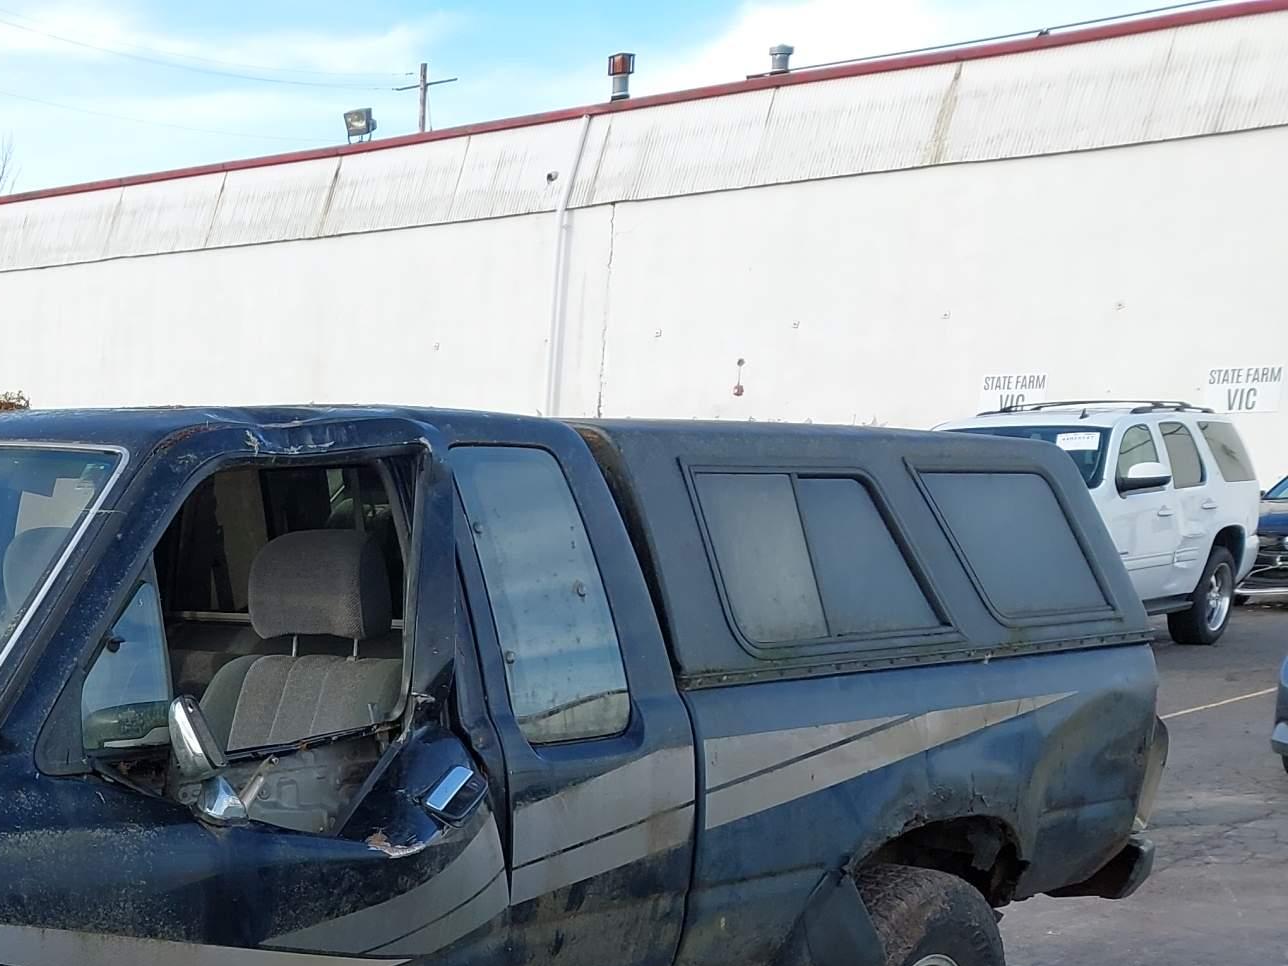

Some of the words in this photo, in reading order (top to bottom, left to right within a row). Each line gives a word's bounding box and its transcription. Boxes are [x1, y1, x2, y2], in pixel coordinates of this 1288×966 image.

[983, 376, 1014, 391] STATE
[1015, 374, 1046, 390] FARM
[1208, 369, 1245, 385] STATE
[1246, 366, 1282, 383] FARM
[1226, 387, 1258, 411] VIC
